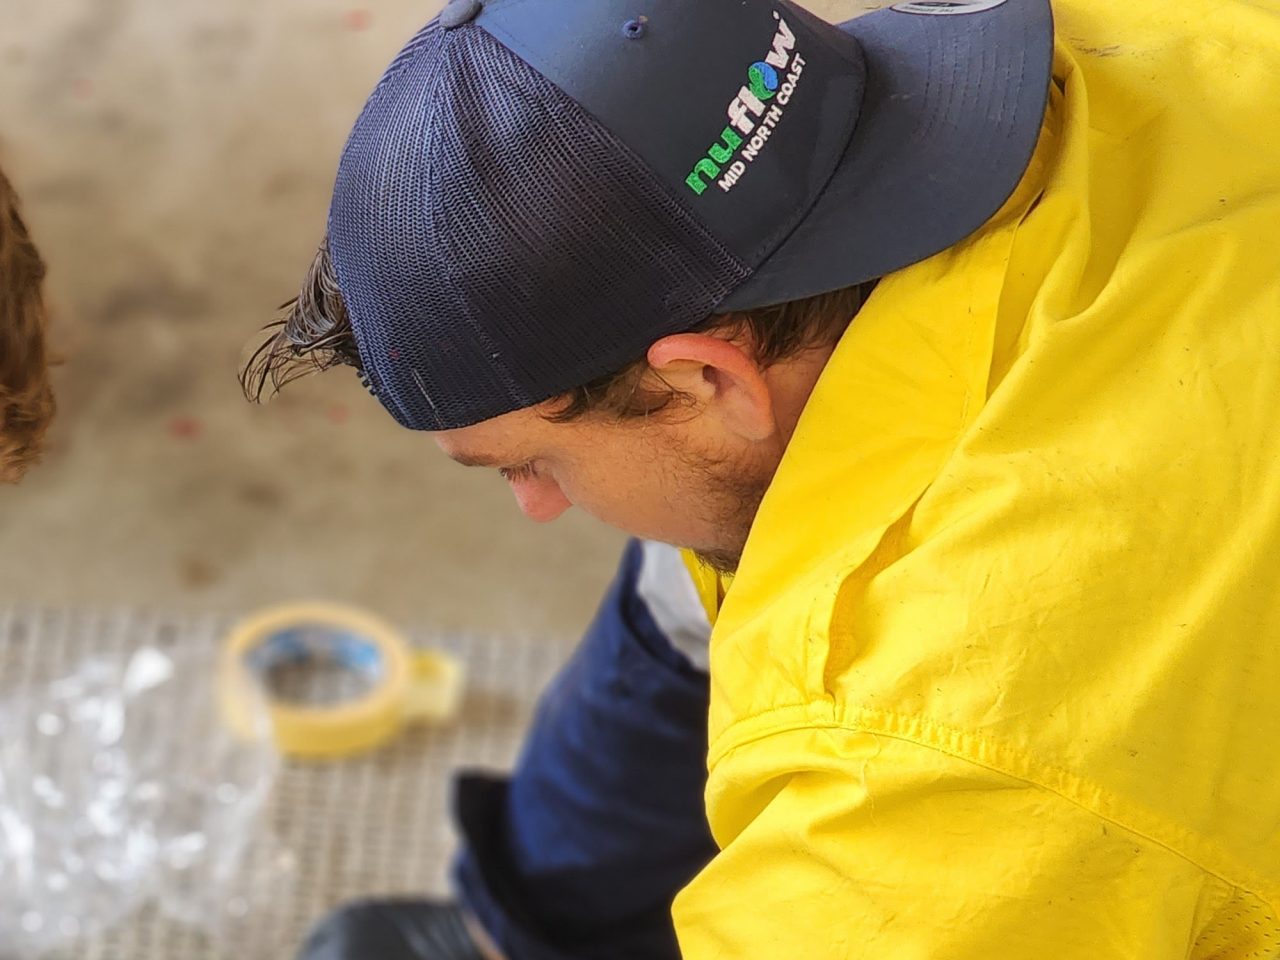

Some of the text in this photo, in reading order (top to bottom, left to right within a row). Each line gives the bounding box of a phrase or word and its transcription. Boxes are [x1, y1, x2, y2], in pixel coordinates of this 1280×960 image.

[685, 18, 796, 195] nuflow
[718, 53, 806, 192] MID NORTH COAST
